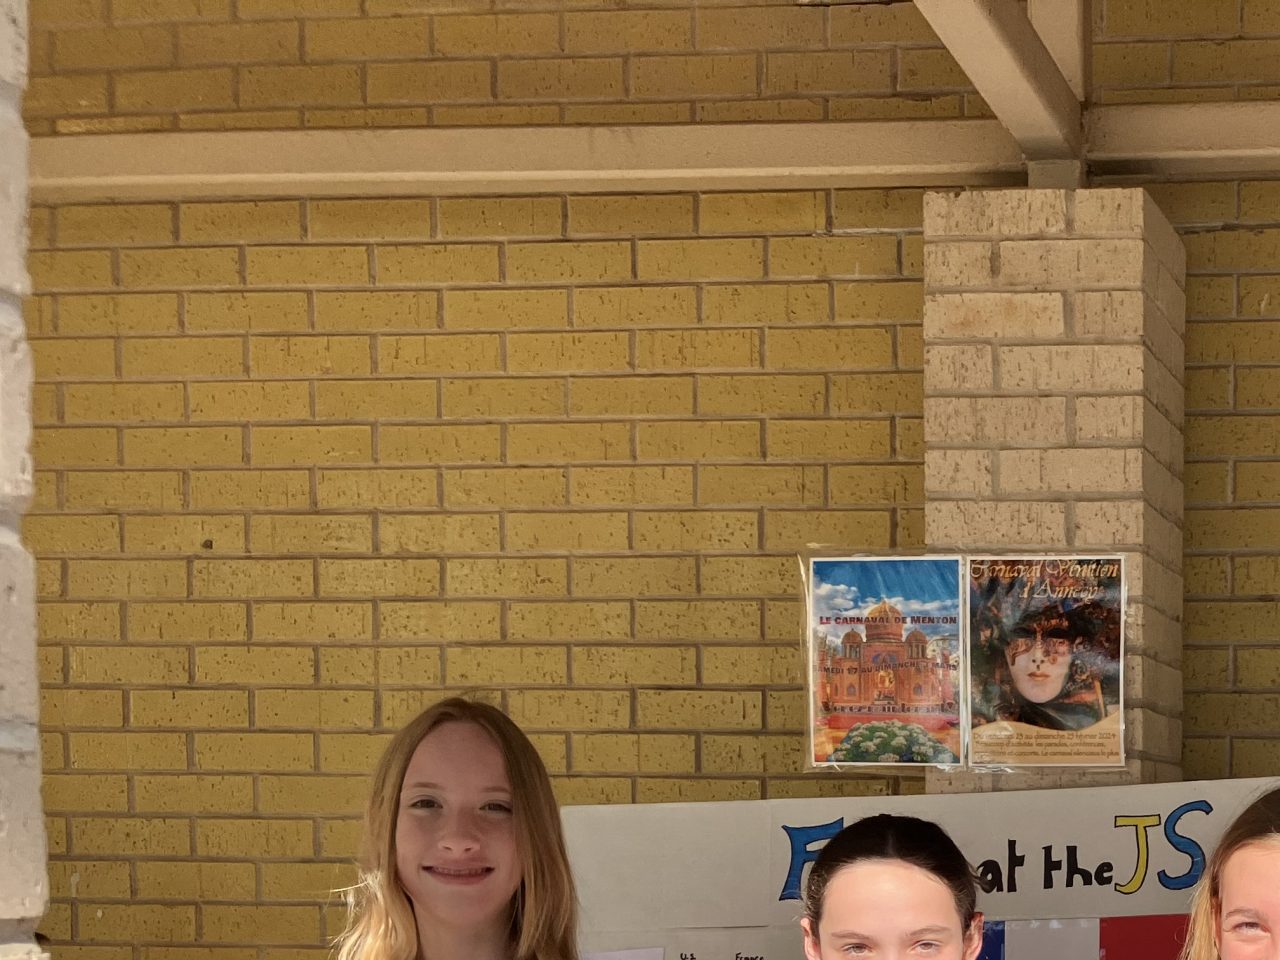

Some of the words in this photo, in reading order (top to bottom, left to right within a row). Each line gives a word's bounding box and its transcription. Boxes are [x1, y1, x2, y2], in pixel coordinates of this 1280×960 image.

[819, 615, 831, 625] LE
[834, 616, 890, 625] CARNAVAL
[894, 616, 908, 625] DE
[975, 838, 1026, 894] at
[1042, 844, 1114, 890] the
